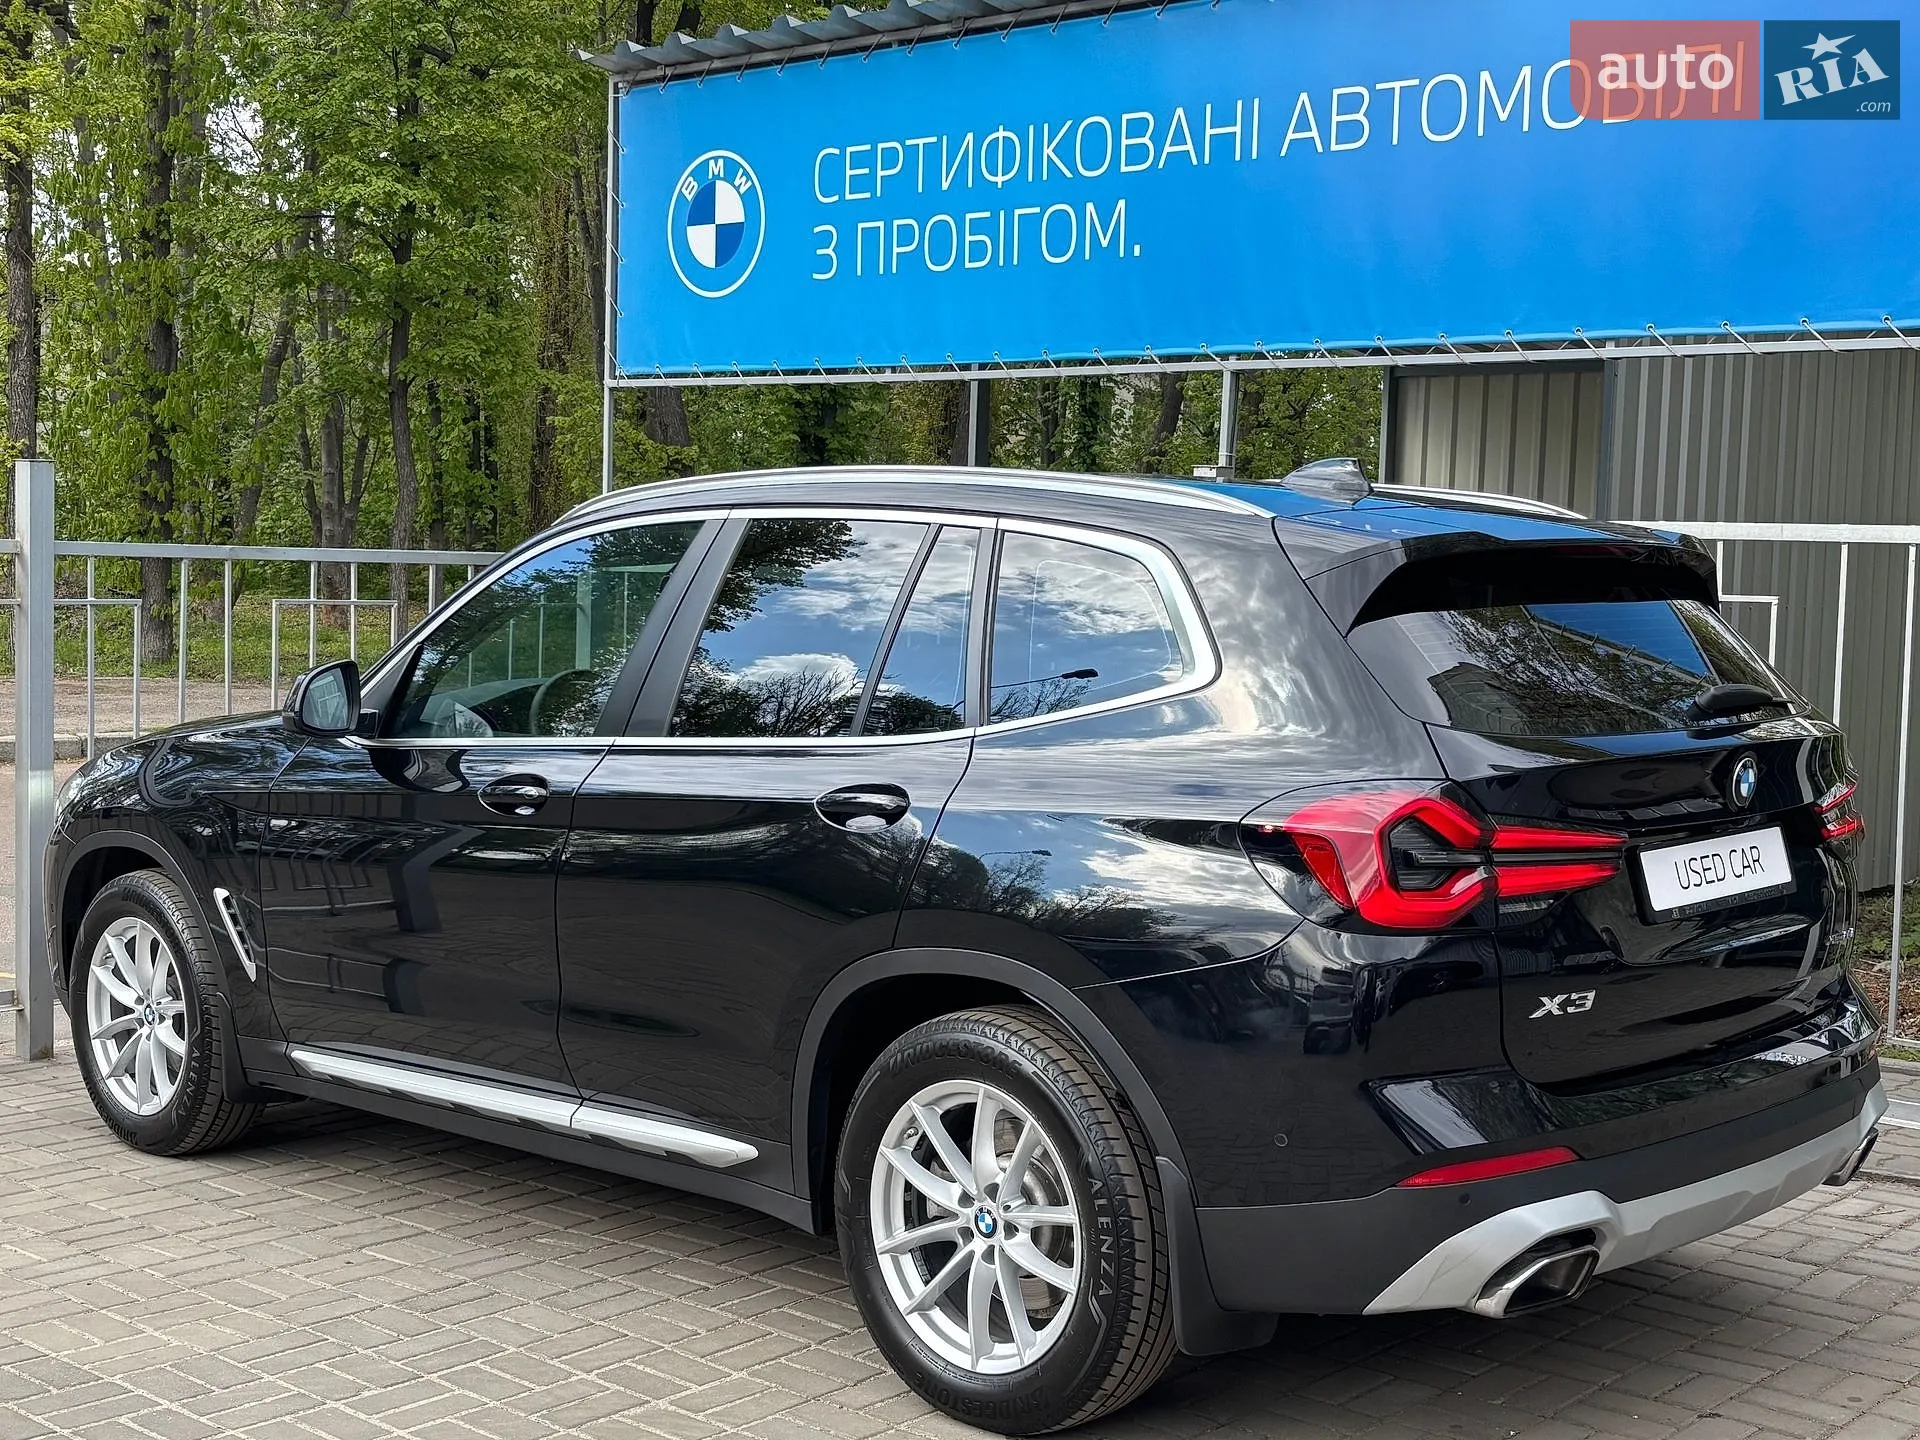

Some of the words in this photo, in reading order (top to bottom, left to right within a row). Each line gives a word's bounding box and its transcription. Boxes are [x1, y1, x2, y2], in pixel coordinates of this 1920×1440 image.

[680, 158, 753, 202] BMW
[813, 97, 1260, 203] СЕРТИФІКОВАНІ
[811, 224, 838, 281] З
[855, 198, 1142, 276] ПРОБІГОМ.
[1674, 853, 1727, 890] USED
[1728, 845, 1765, 878] CAR
[1528, 989, 1596, 1019] X3
[1087, 1178, 1115, 1296] ALENZA
